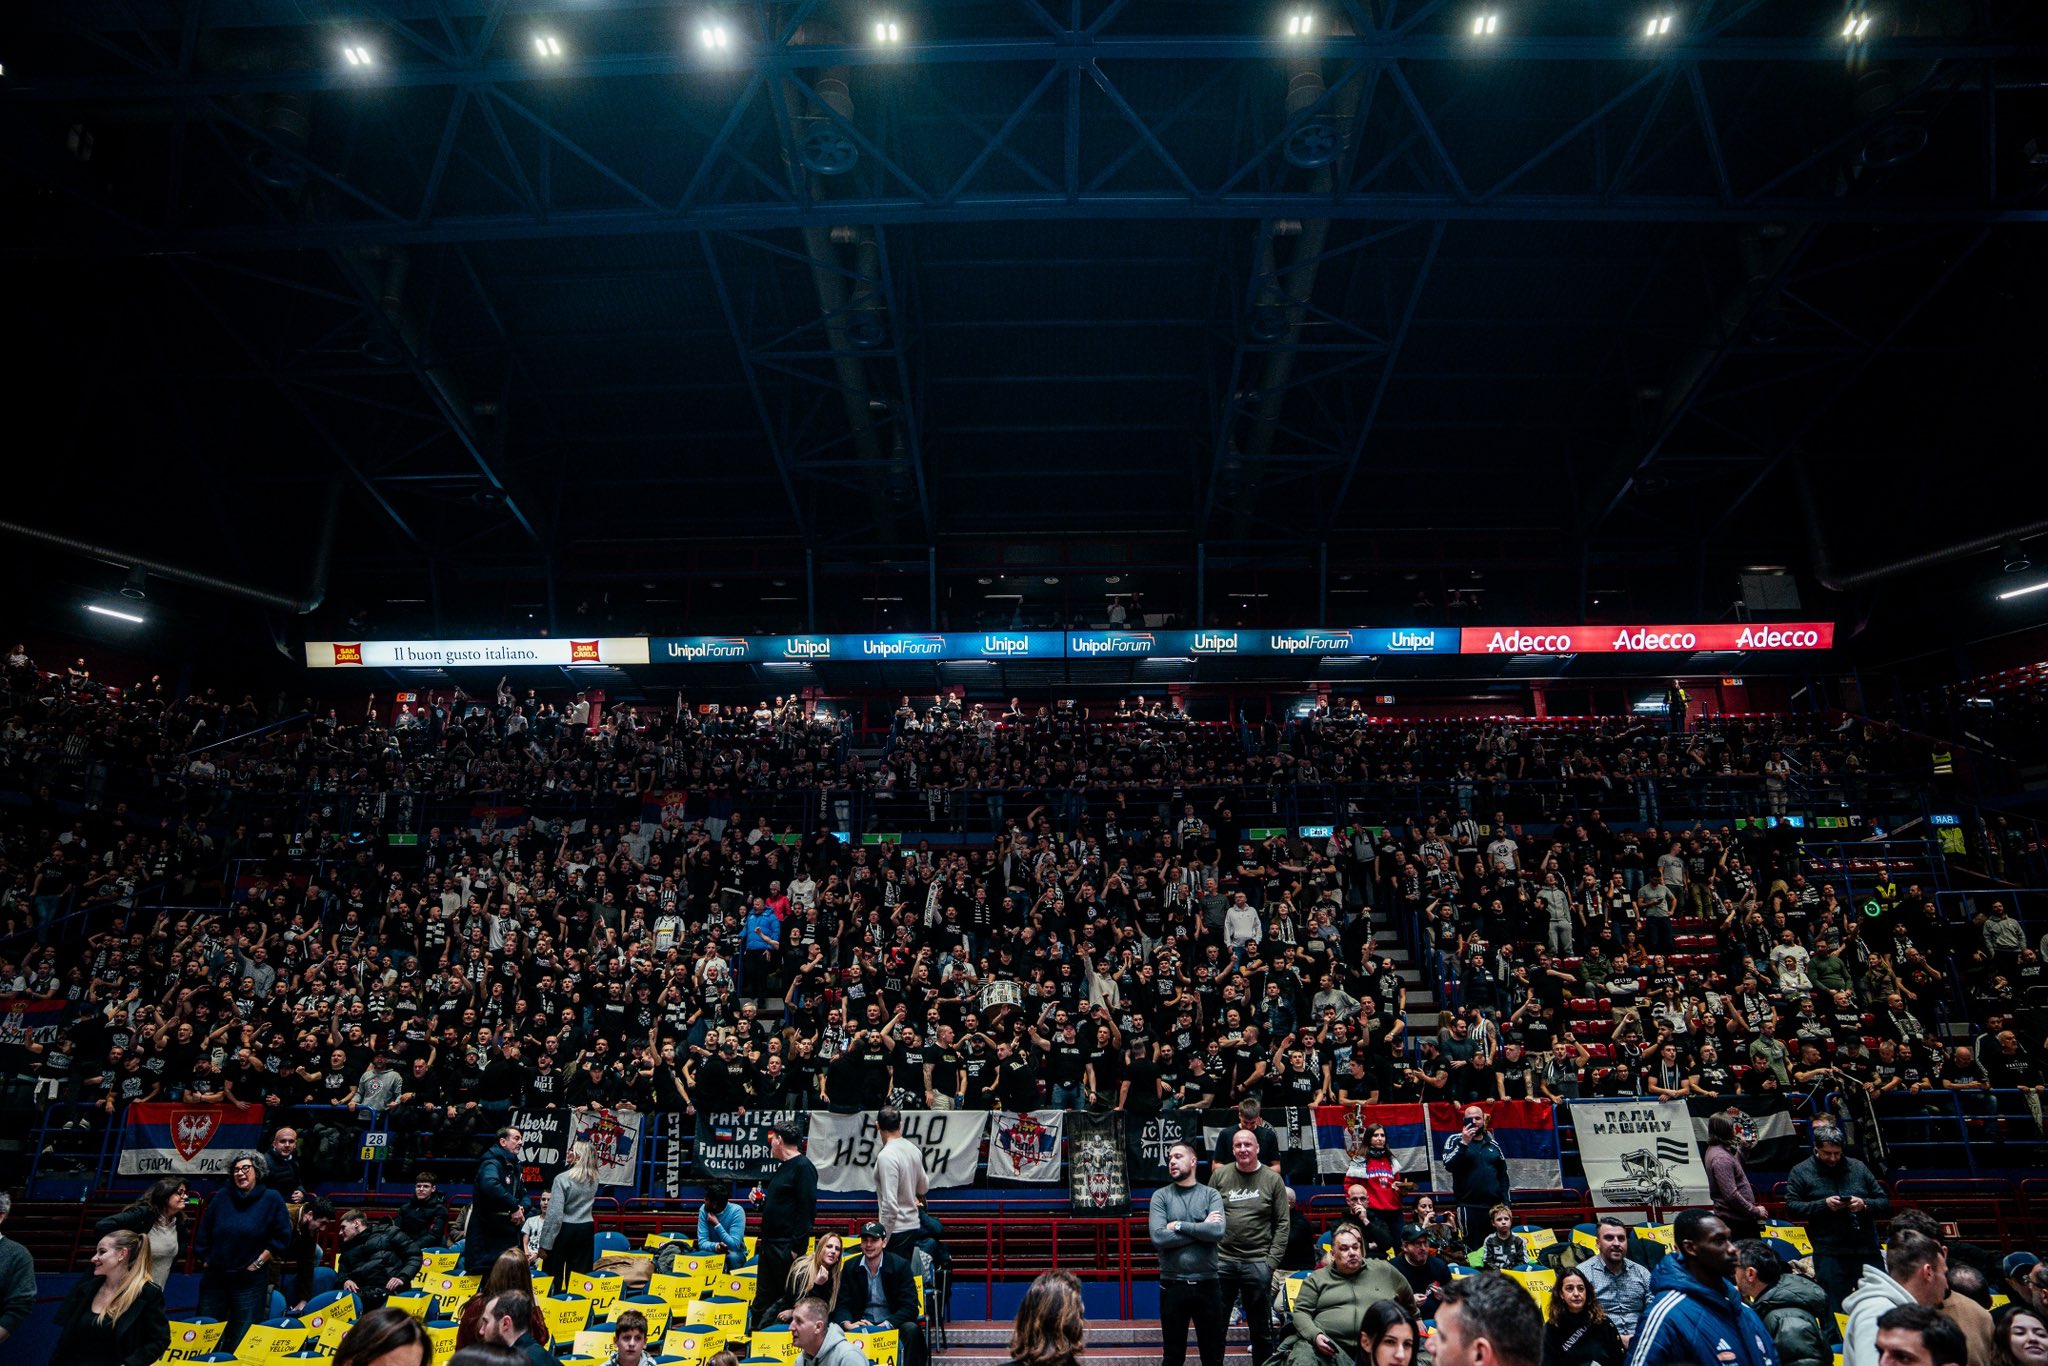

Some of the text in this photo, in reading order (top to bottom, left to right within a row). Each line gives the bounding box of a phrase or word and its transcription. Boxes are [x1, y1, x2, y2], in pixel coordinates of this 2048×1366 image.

[1195, 633, 1237, 652] Unipol
[1392, 631, 1434, 650] Unipol
[1487, 630, 1570, 653] Adecco
[1612, 628, 1696, 651] Adecco
[1735, 627, 1818, 648] Adecco
[340, 647, 355, 655] SAN
[577, 643, 593, 651] SAN
[787, 638, 830, 657] Unipol
[985, 636, 1028, 656] Unipol
[394, 646, 538, 665] Il buon gusto italiano.
[573, 650, 597, 659] CARLO
[408, 693, 415, 701] 27
[709, 1111, 796, 1126] PARTIZAN
[1605, 1110, 1655, 1122] ПАЛИ
[736, 1127, 758, 1141] DE
[1593, 1121, 1671, 1134] МАШИНУ
[369, 1135, 383, 1144] 28
[522, 1130, 543, 1146] per
[517, 1146, 560, 1164] AVID
[699, 1142, 774, 1160] FUENLABR
[138, 1157, 173, 1171] СТАРИ
[704, 1159, 745, 1170] COLEGIO
[435, 1346, 456, 1354] YELLO
[782, 1348, 803, 1357] YELLO
